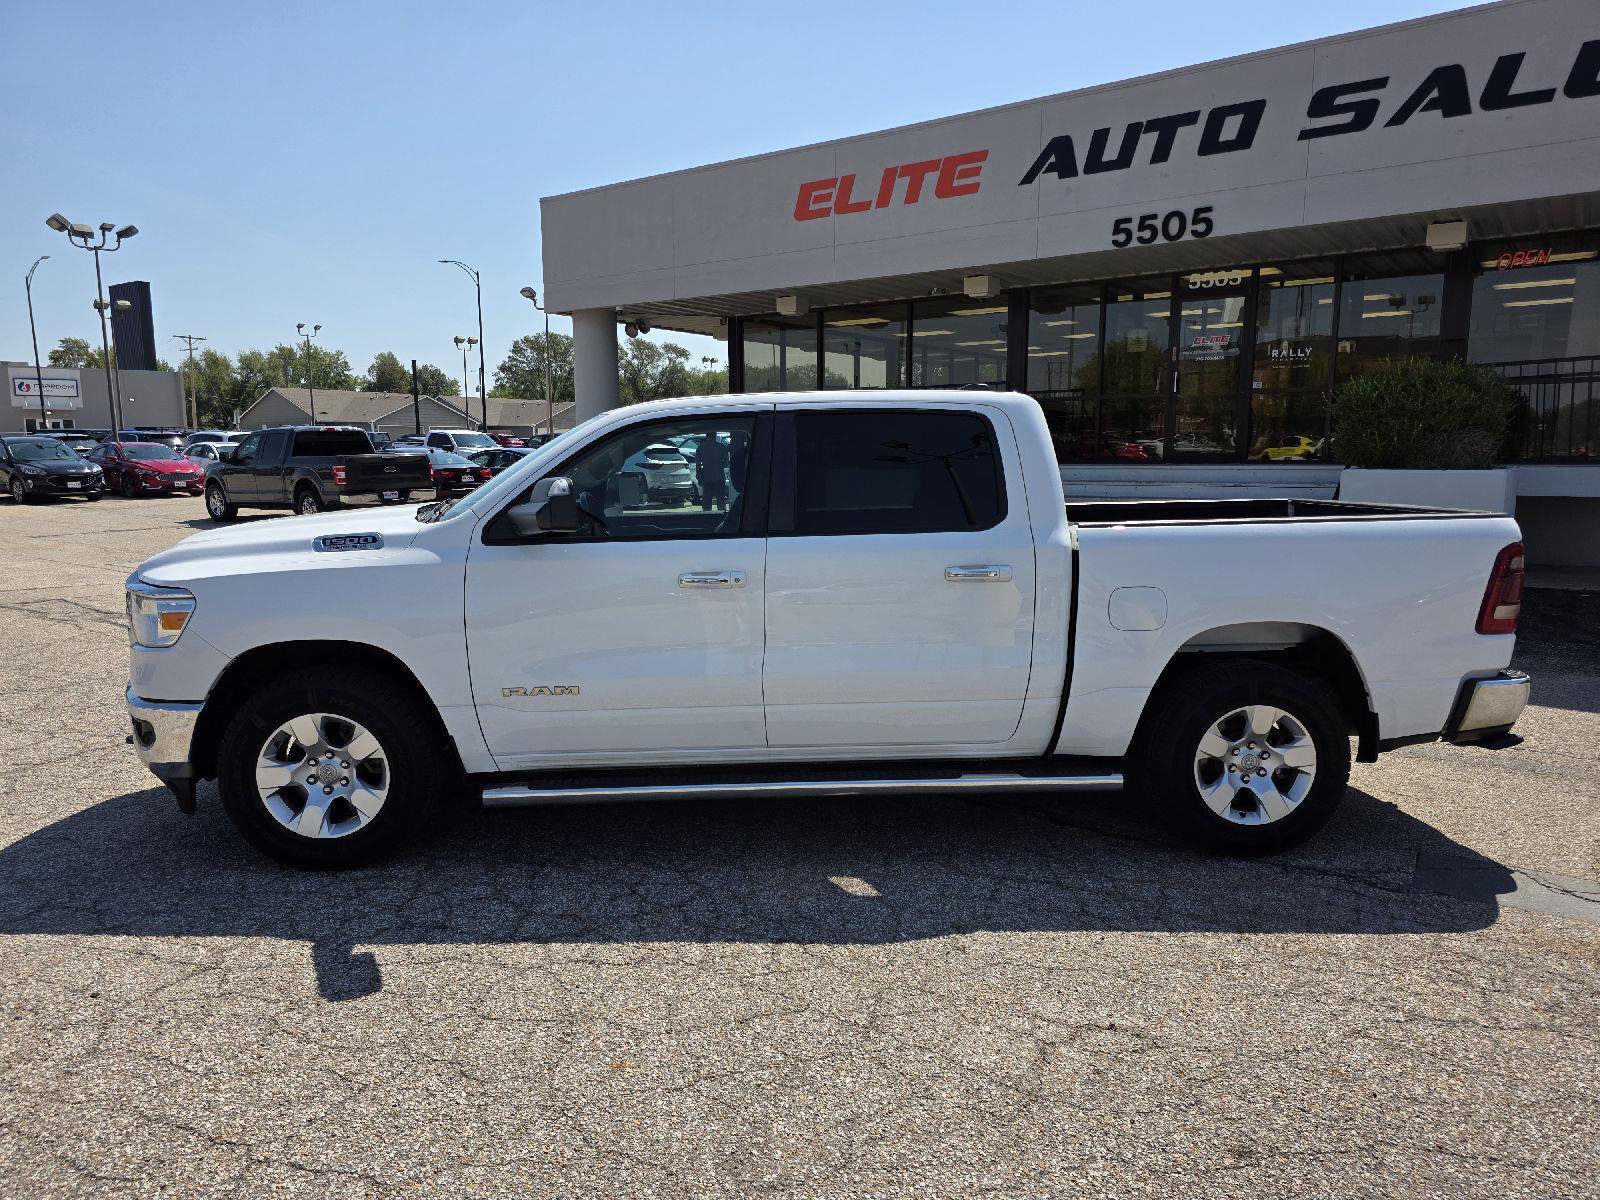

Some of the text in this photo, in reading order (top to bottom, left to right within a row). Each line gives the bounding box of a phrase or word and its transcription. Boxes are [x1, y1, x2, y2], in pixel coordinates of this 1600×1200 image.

[793, 149, 989, 222] ELITE
[1018, 99, 1267, 187] AUTO
[1111, 206, 1215, 249] 5505
[1497, 247, 1553, 270] OPEN
[1188, 269, 1242, 289] 5505
[1271, 347, 1313, 358] RALLY
[323, 535, 373, 546] 1500
[501, 685, 580, 698] RAM
